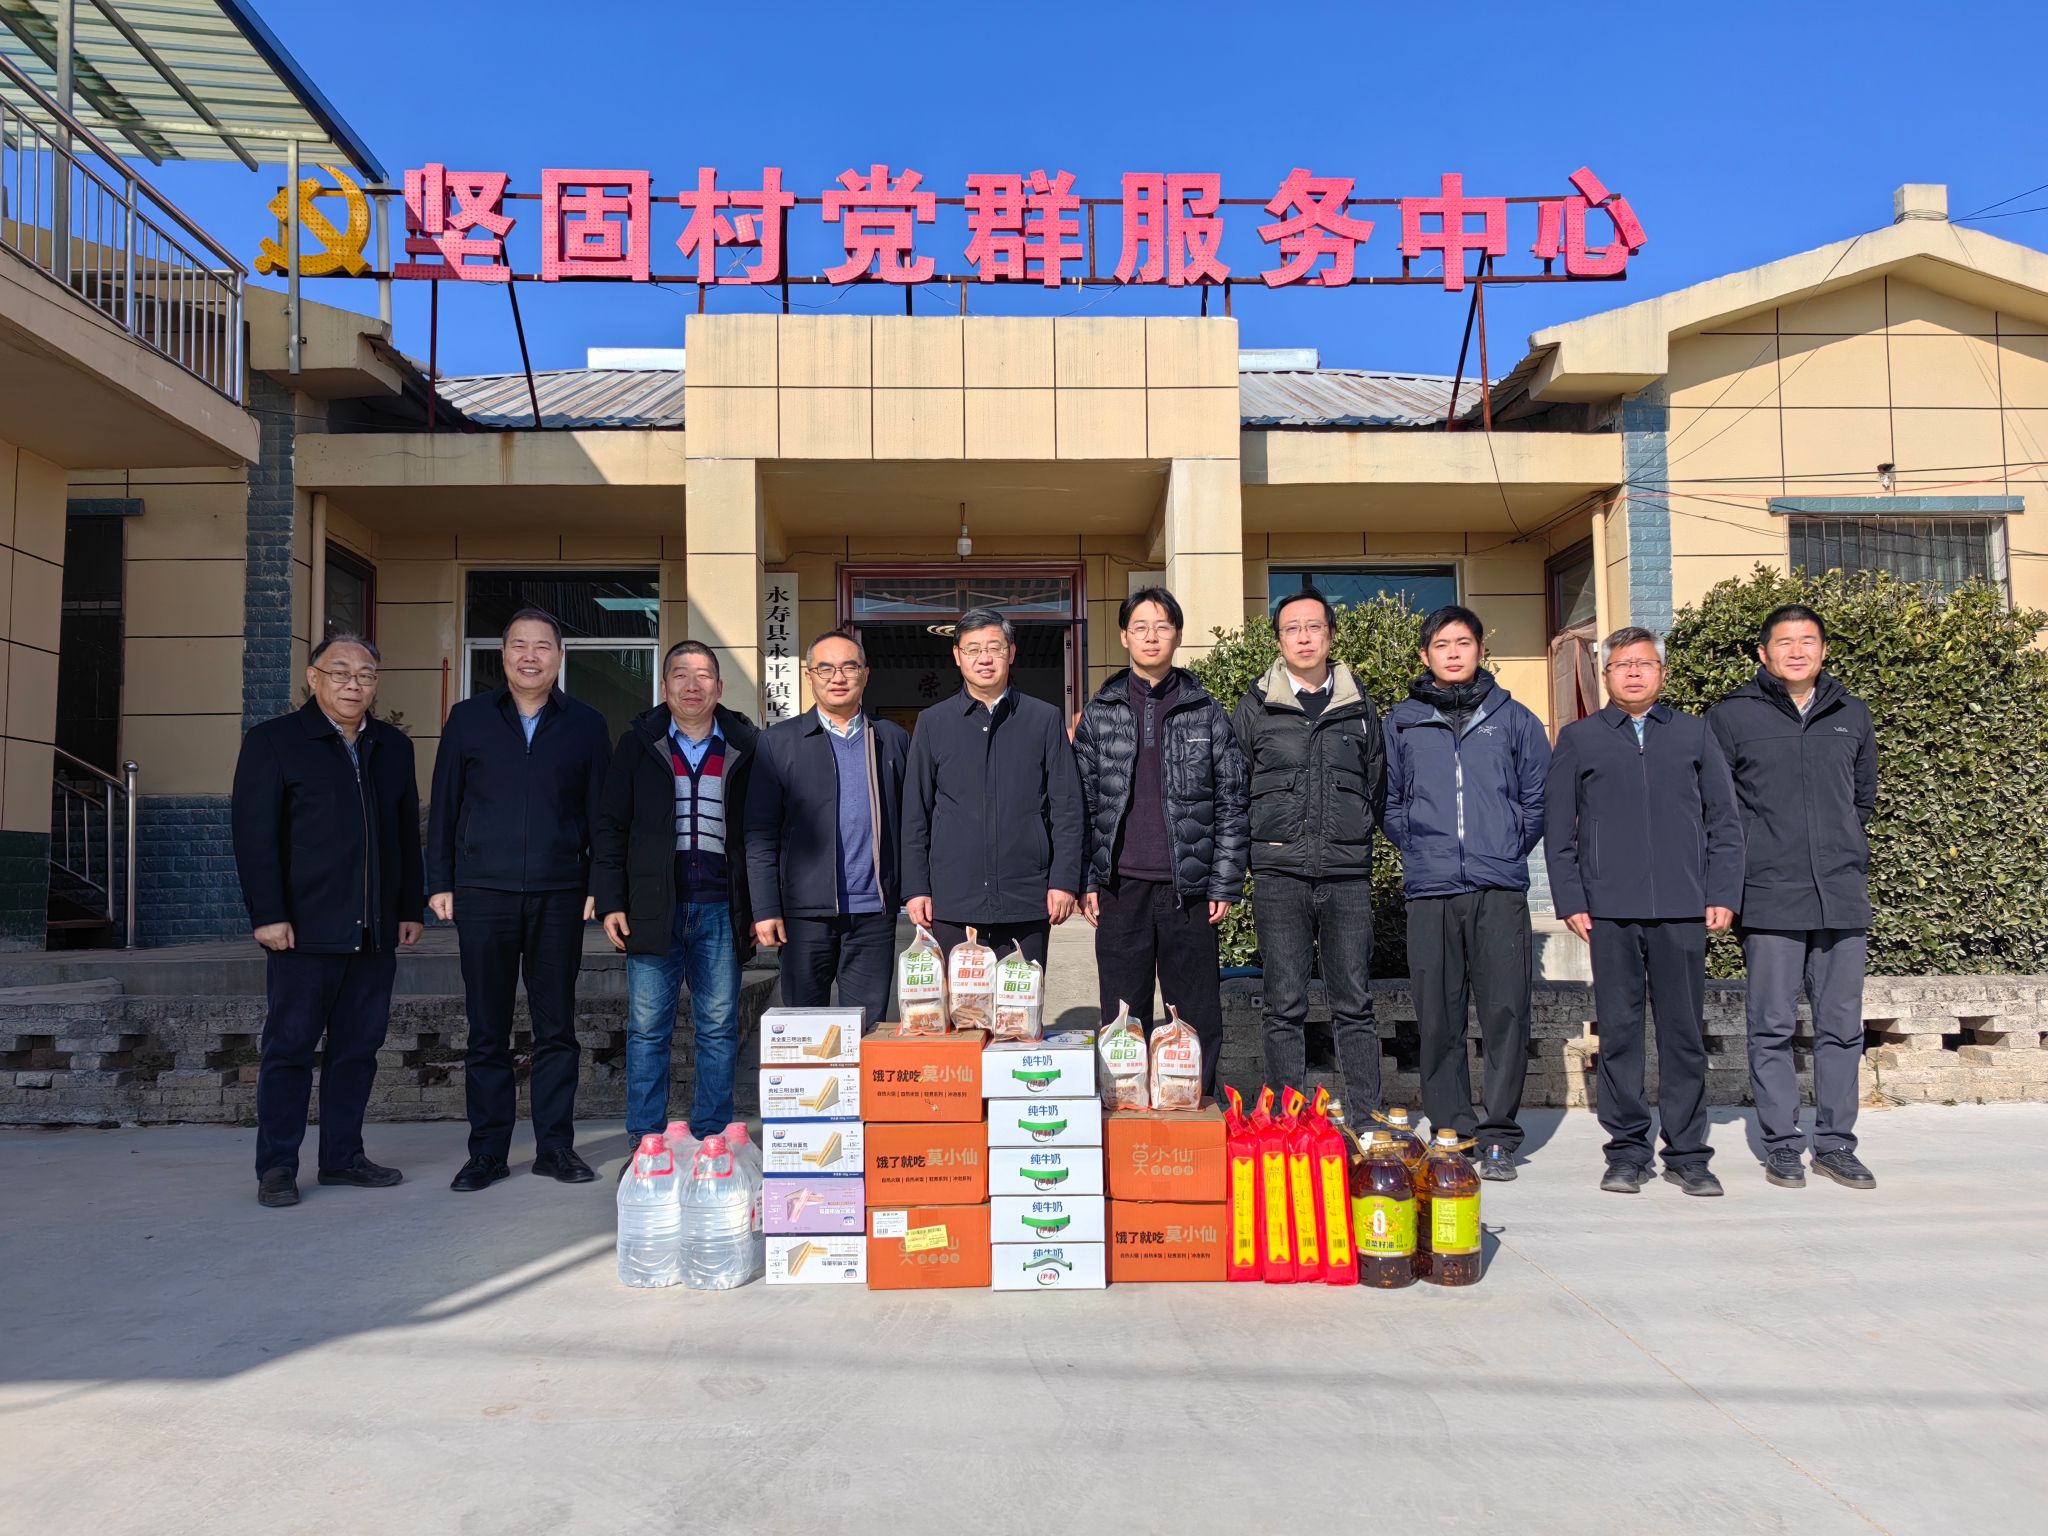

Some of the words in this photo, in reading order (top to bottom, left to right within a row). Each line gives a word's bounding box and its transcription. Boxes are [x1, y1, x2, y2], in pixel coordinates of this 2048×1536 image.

[395, 162, 1646, 292] 坚固村党群服务中心
[764, 586, 792, 729] 永寿县永平镇坚
[958, 967, 985, 979] 面包
[906, 973, 934, 986] 面包
[1003, 980, 1031, 993] 面包
[1110, 1048, 1137, 1060] 面包
[1163, 1049, 1191, 1060] 面包
[1022, 1054, 1053, 1067] 纯牛奶
[1027, 1104, 1059, 1117] 纯牛奶
[1030, 1153, 1061, 1165] 纯牛奶
[1032, 1201, 1063, 1213] 纯牛奶
[1039, 1272, 1057, 1281] 伊利
